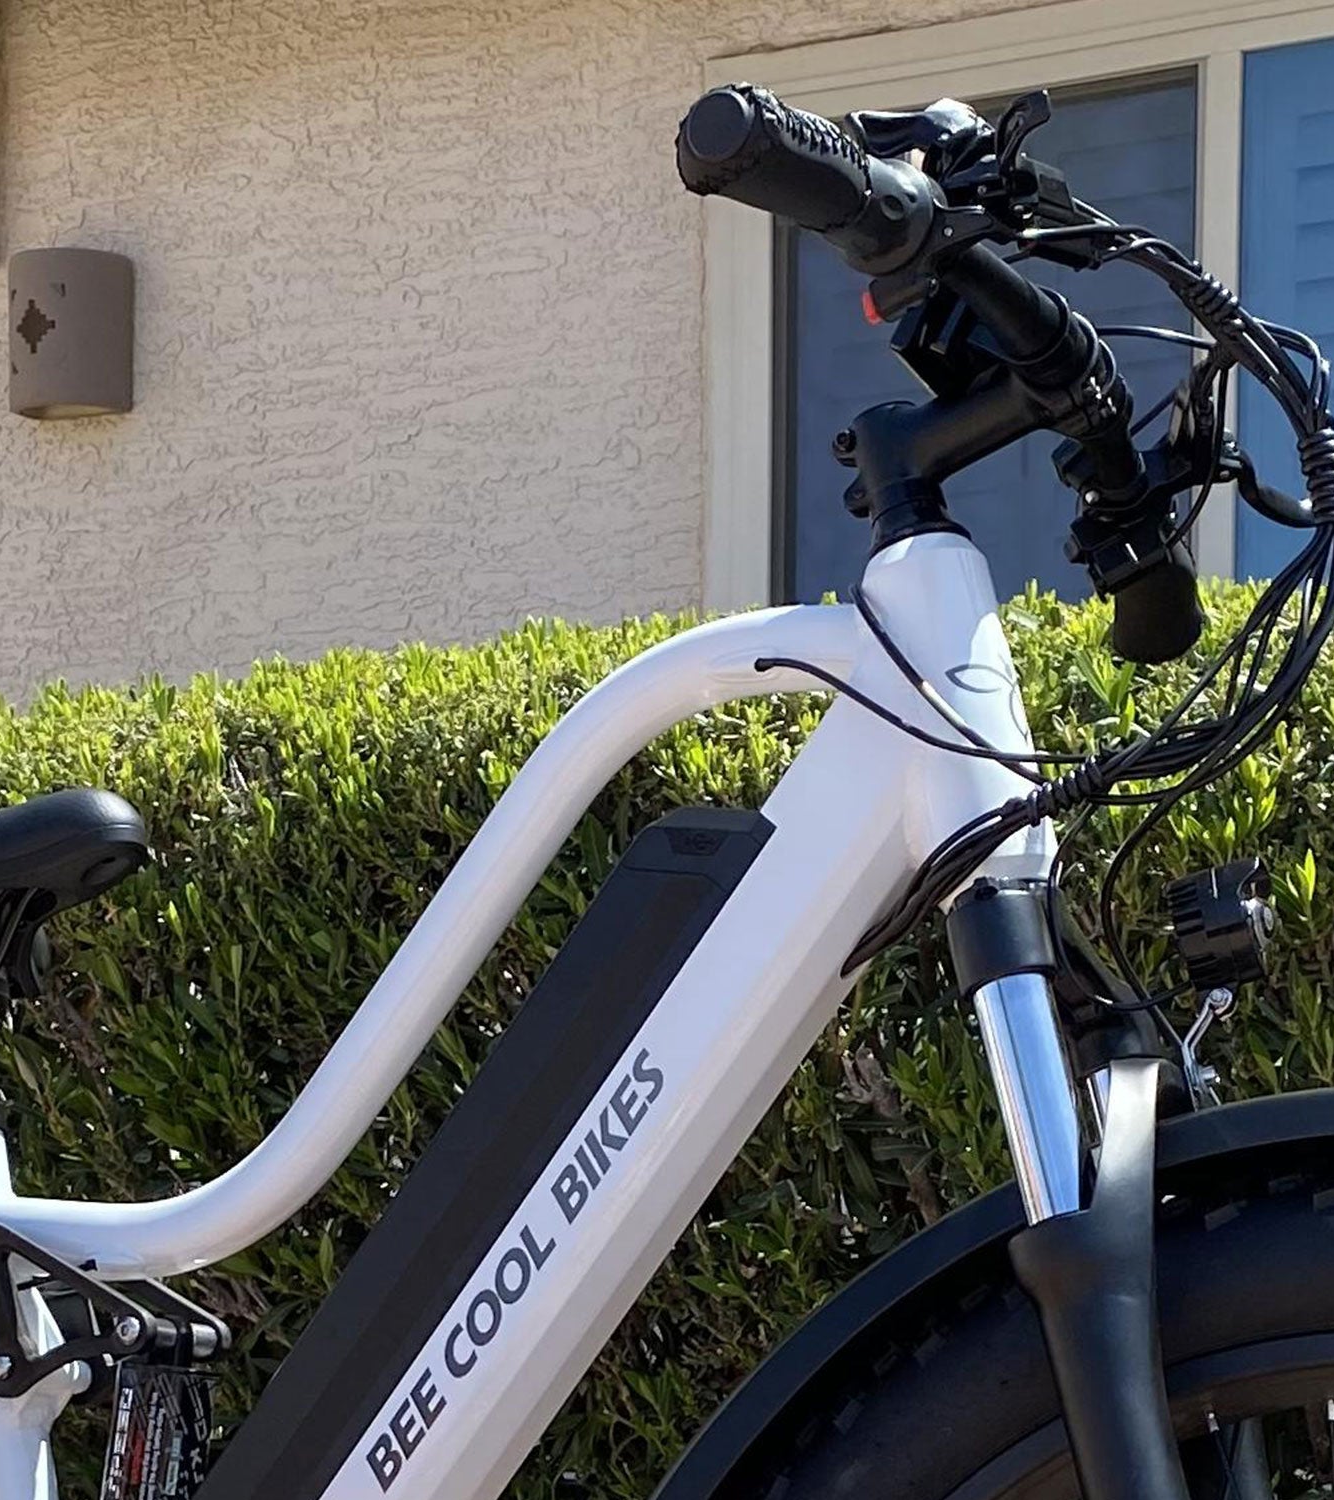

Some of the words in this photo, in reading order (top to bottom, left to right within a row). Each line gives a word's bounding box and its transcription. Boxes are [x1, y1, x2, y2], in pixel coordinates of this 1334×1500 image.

[366, 1367, 447, 1493] BEE
[444, 1225, 557, 1379] COOL
[551, 1048, 664, 1225] BIKES
